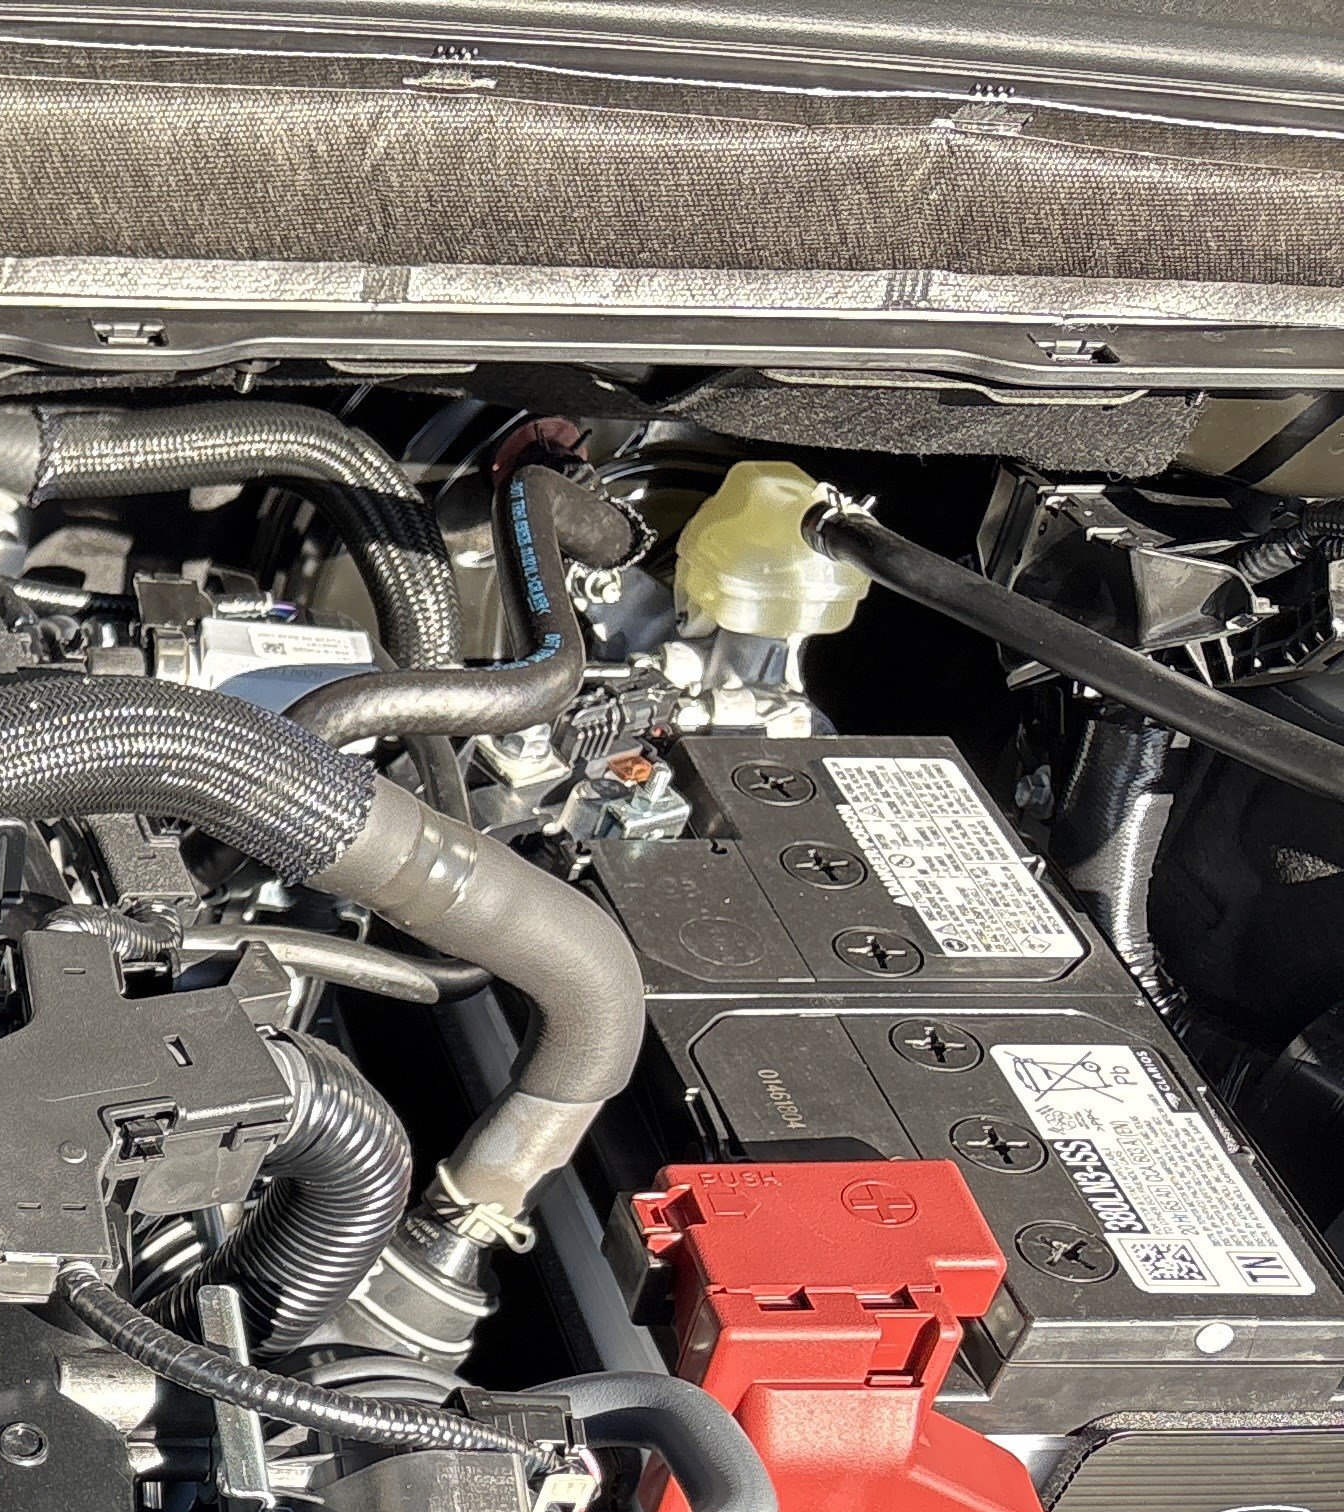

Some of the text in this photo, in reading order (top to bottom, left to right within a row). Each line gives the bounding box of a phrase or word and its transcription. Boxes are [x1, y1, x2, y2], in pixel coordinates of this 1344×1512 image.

[1104, 1065, 1139, 1085] Pb
[1134, 1050, 1172, 1090] CLARIOS
[698, 1170, 782, 1188] PUSH
[1137, 1165, 1164, 1181] CCA
[1051, 1140, 1144, 1230] 380LN3-ISS
[1151, 1187, 1173, 1197] Ah
[1159, 1200, 1182, 1209] 65
[1168, 1213, 1191, 1222] Hr
[1175, 1224, 1200, 1235] 20
[1235, 1256, 1293, 1282] TN
